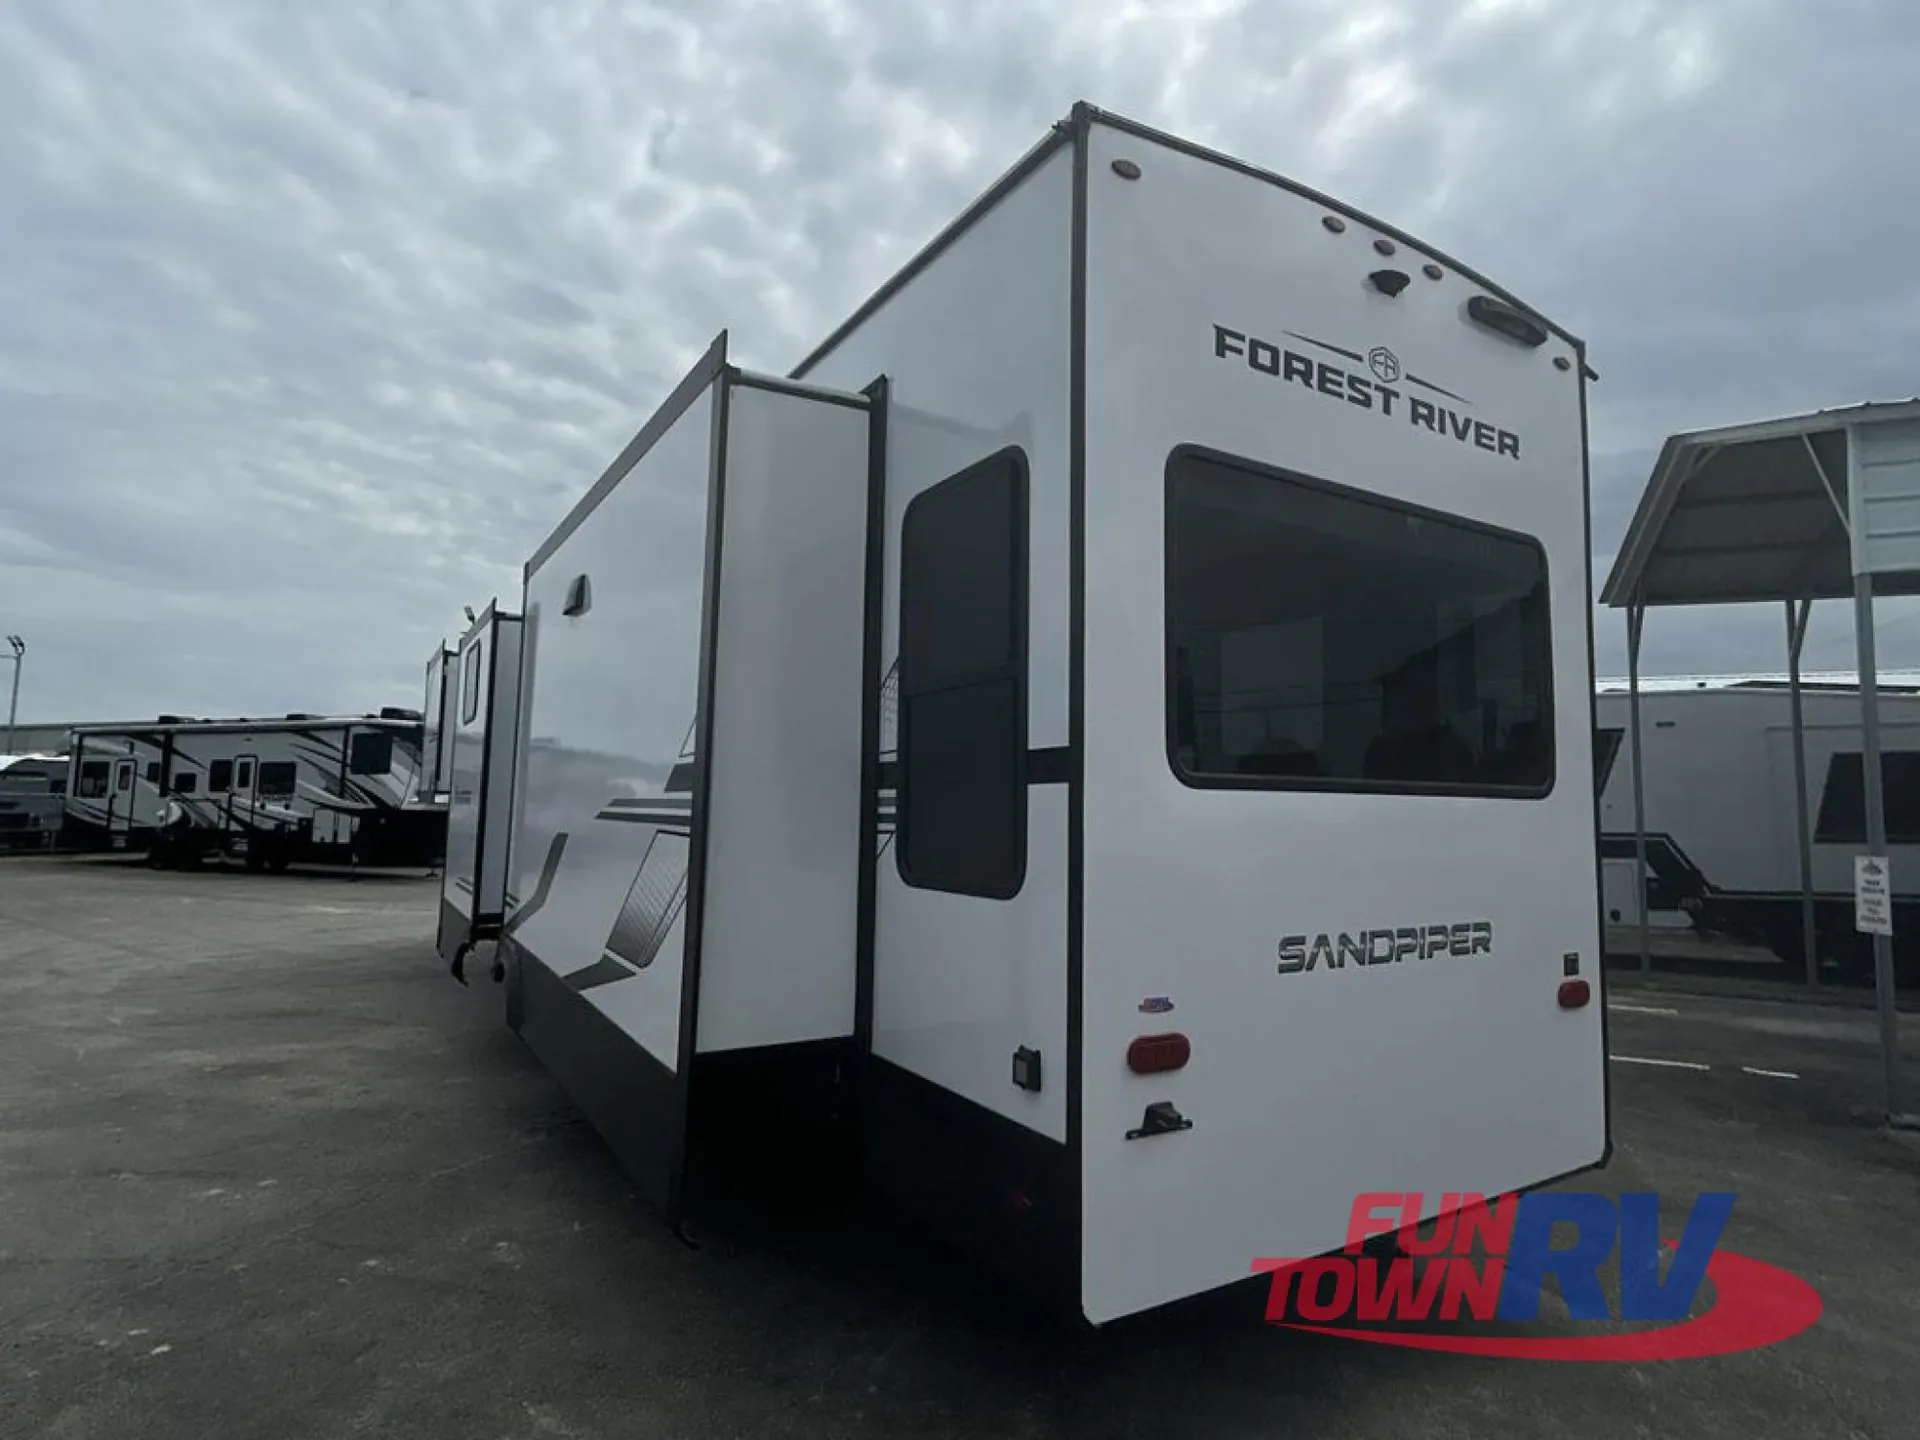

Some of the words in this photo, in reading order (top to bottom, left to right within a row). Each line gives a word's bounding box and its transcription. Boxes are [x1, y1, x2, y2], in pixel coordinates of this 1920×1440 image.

[1213, 323, 1400, 416] FOREST
[1410, 397, 1520, 460] RIVER
[1277, 922, 1492, 974] SANDPIPER
